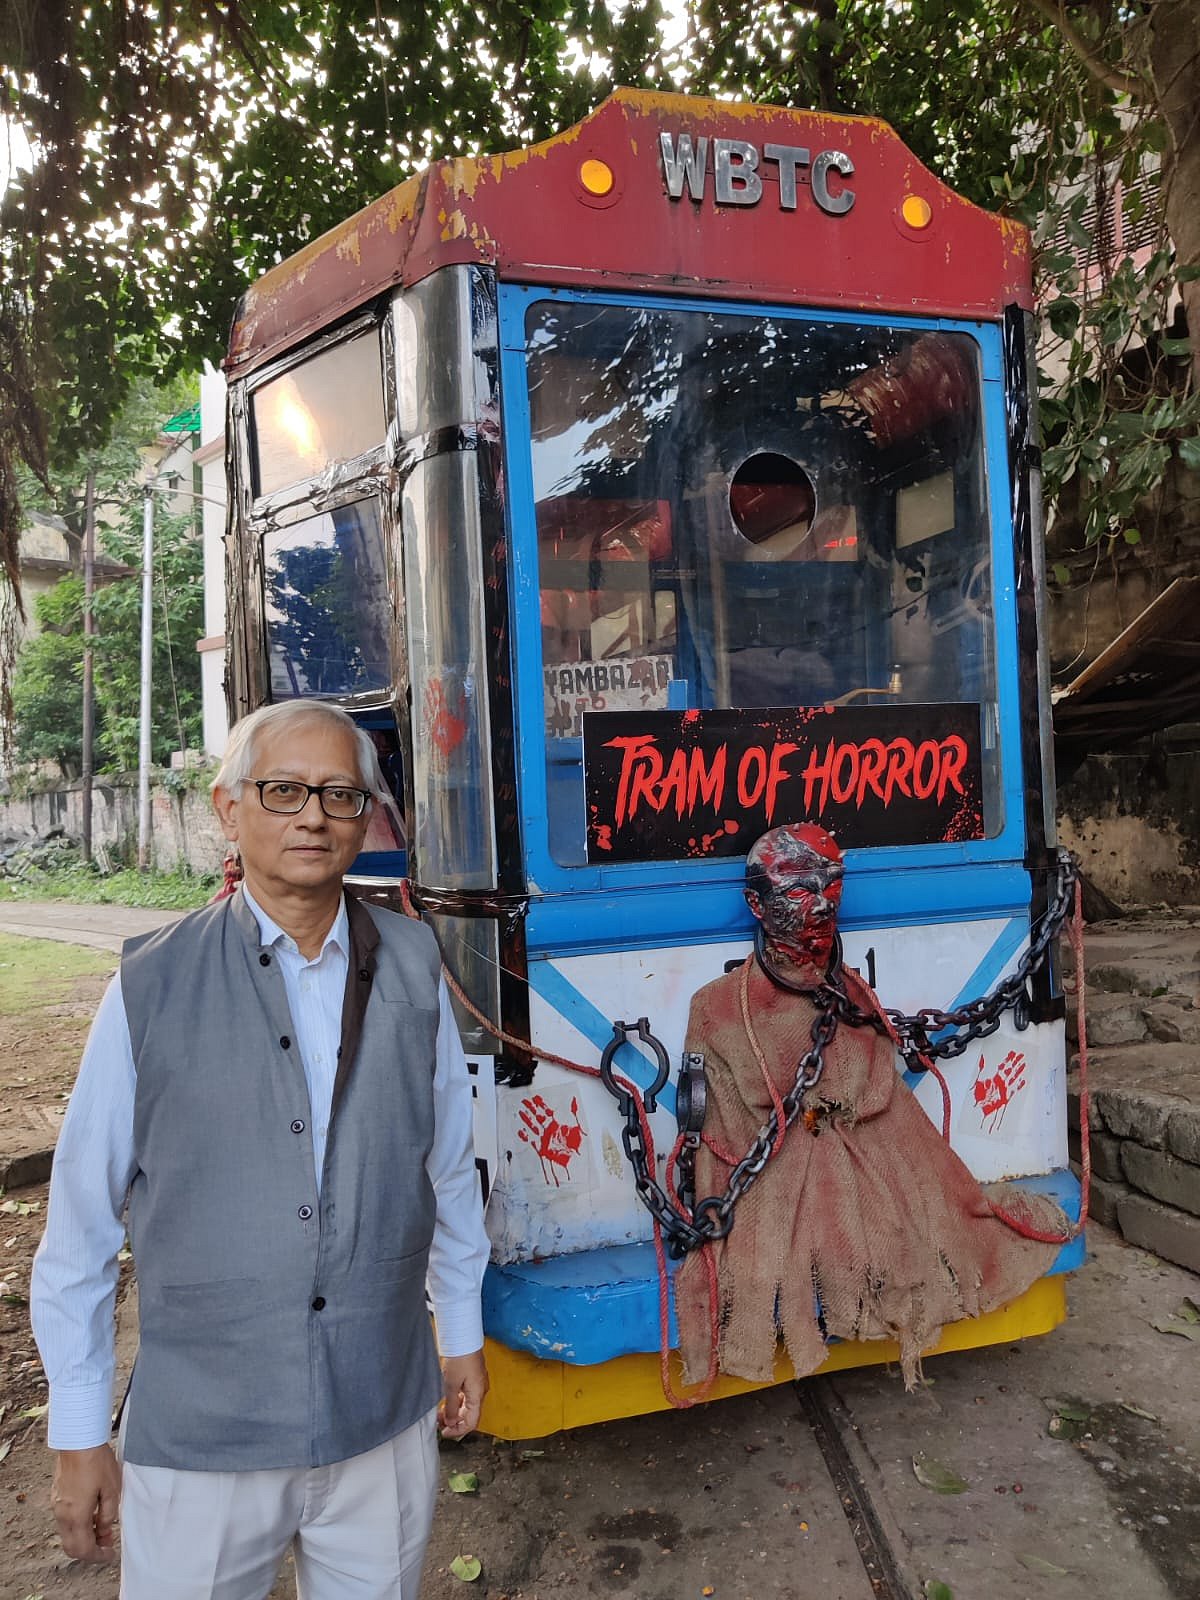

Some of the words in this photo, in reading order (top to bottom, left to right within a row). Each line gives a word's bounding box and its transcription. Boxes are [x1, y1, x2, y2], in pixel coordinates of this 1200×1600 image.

[659, 131, 856, 214] WBTC
[601, 734, 728, 834] TRAM
[737, 741, 801, 827] OF
[799, 734, 968, 818] HORROR
